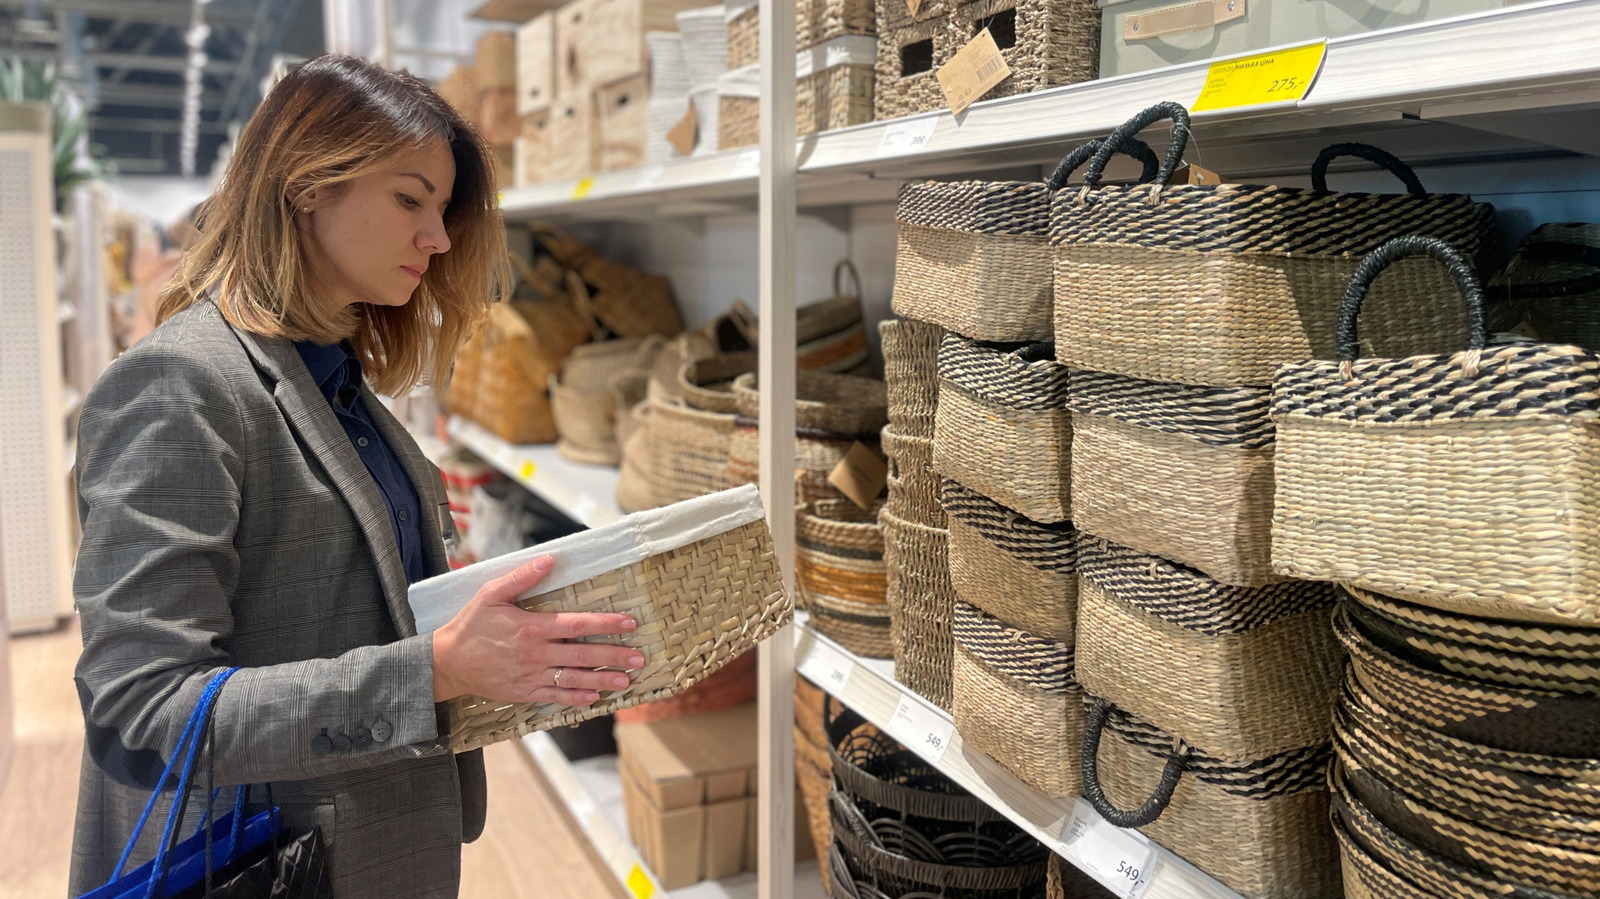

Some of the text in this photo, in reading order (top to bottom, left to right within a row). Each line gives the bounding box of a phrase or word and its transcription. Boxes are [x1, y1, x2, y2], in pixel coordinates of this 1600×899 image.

[1267, 77, 1305, 92] 275,-
[926, 733, 944, 751] 549,-
[1117, 860, 1144, 886] 549,-
